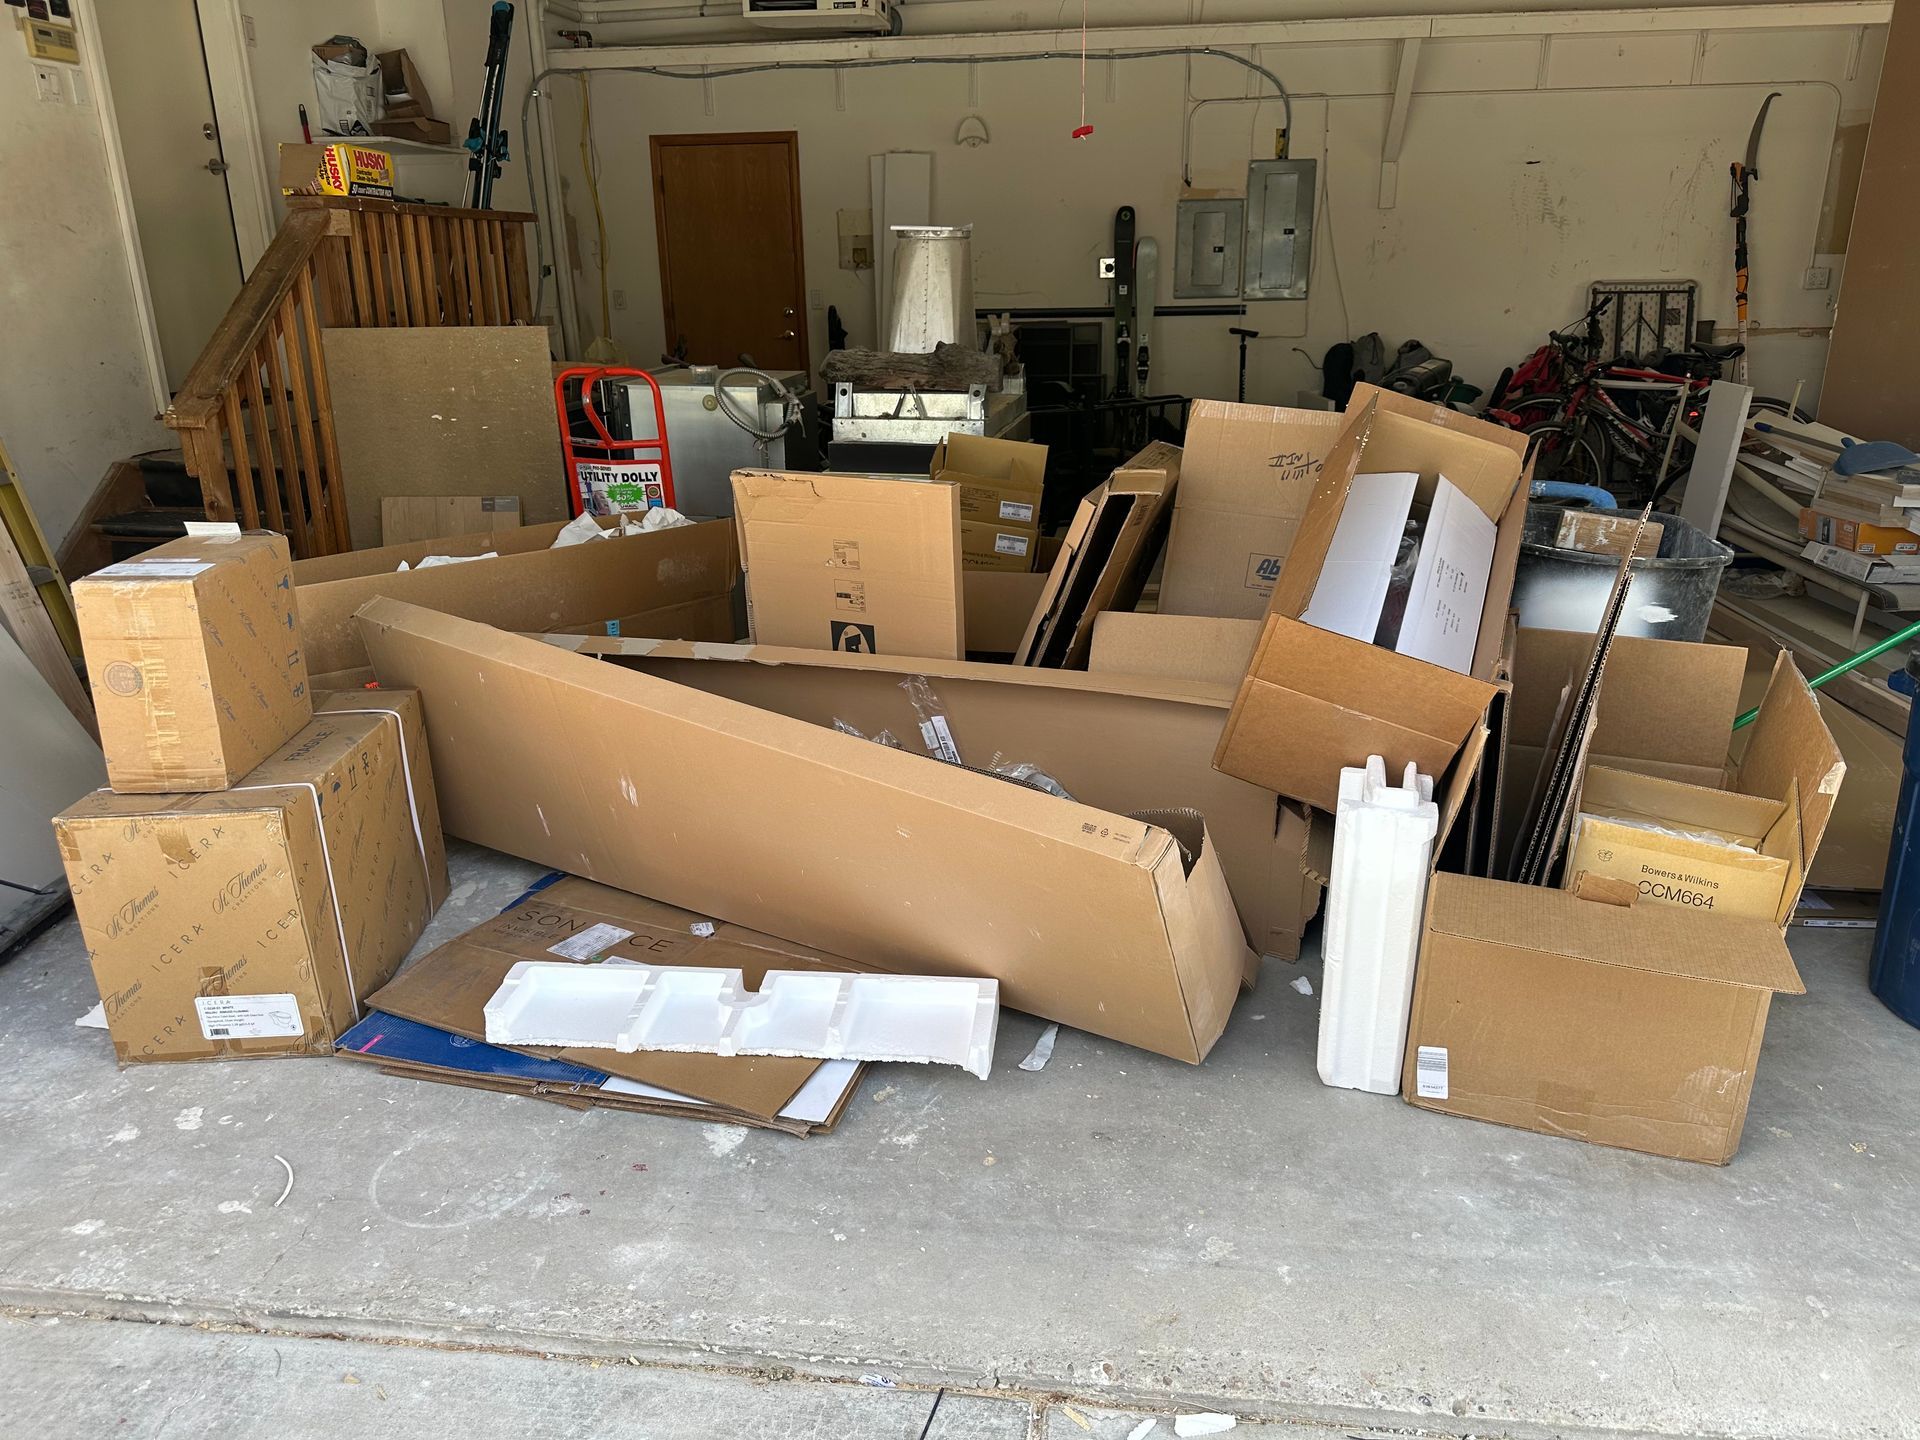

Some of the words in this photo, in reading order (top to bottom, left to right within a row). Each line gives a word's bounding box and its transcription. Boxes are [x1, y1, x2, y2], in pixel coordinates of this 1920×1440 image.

[325, 146, 344, 192] HUSKY
[353, 150, 386, 171] HUSKY
[580, 471, 618, 483] UTILITY
[621, 471, 658, 483] DOLLY
[1256, 558, 1281, 576] Ab
[284, 730, 334, 762] FRAGILE
[168, 825, 225, 879] ICERA
[71, 852, 115, 896] CERA
[227, 858, 268, 900] Thomas
[1641, 864, 1676, 880] Bowers
[1676, 873, 1684, 882] &
[1684, 873, 1719, 890] Wilkins
[120, 885, 160, 925] Thomas
[231, 877, 268, 911] CREATIONS
[1638, 880, 1714, 909] CCM664
[125, 902, 161, 936] CREATIONS
[256, 908, 299, 949] ICER
[151, 922, 206, 973] ICERA
[104, 978, 142, 1017] Thomas
[134, 1015, 187, 1064] ICERA
